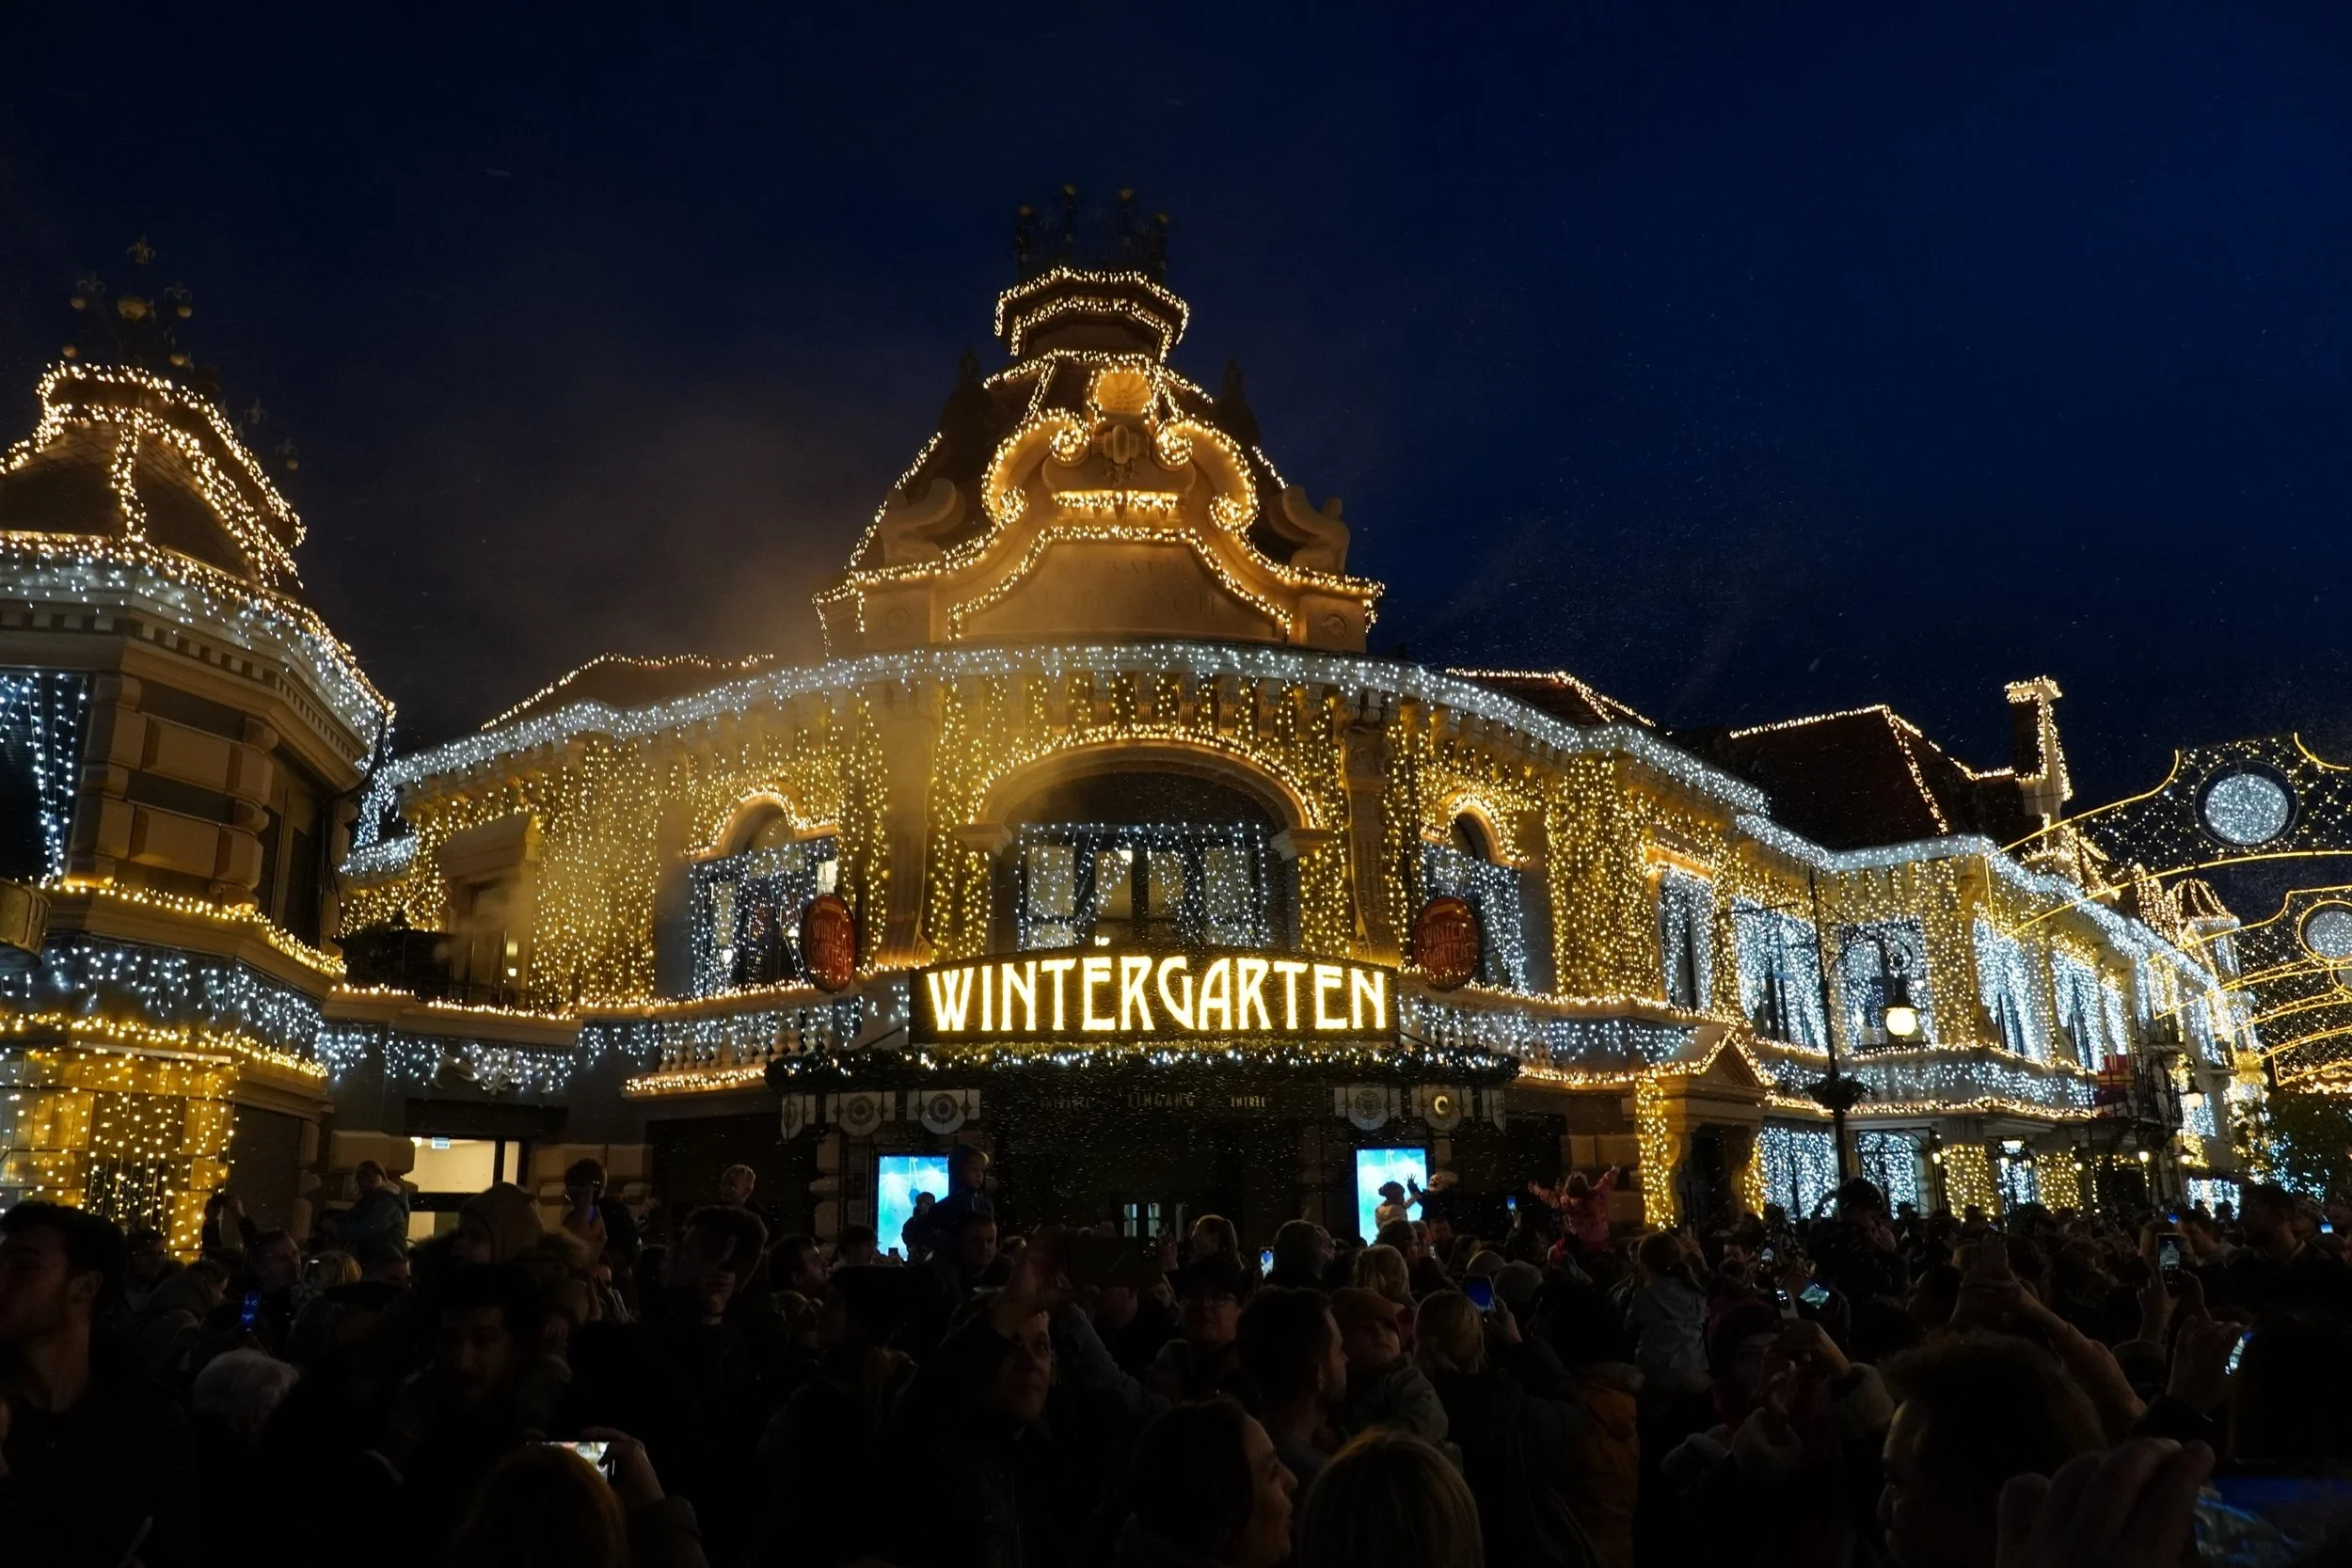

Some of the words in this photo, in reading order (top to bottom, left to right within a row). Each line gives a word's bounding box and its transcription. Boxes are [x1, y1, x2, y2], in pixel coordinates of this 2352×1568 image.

[1422, 921, 1467, 948] WINTER
[1422, 943, 1469, 966] GARTEN
[927, 956, 1387, 1031] WINTERGARTEN
